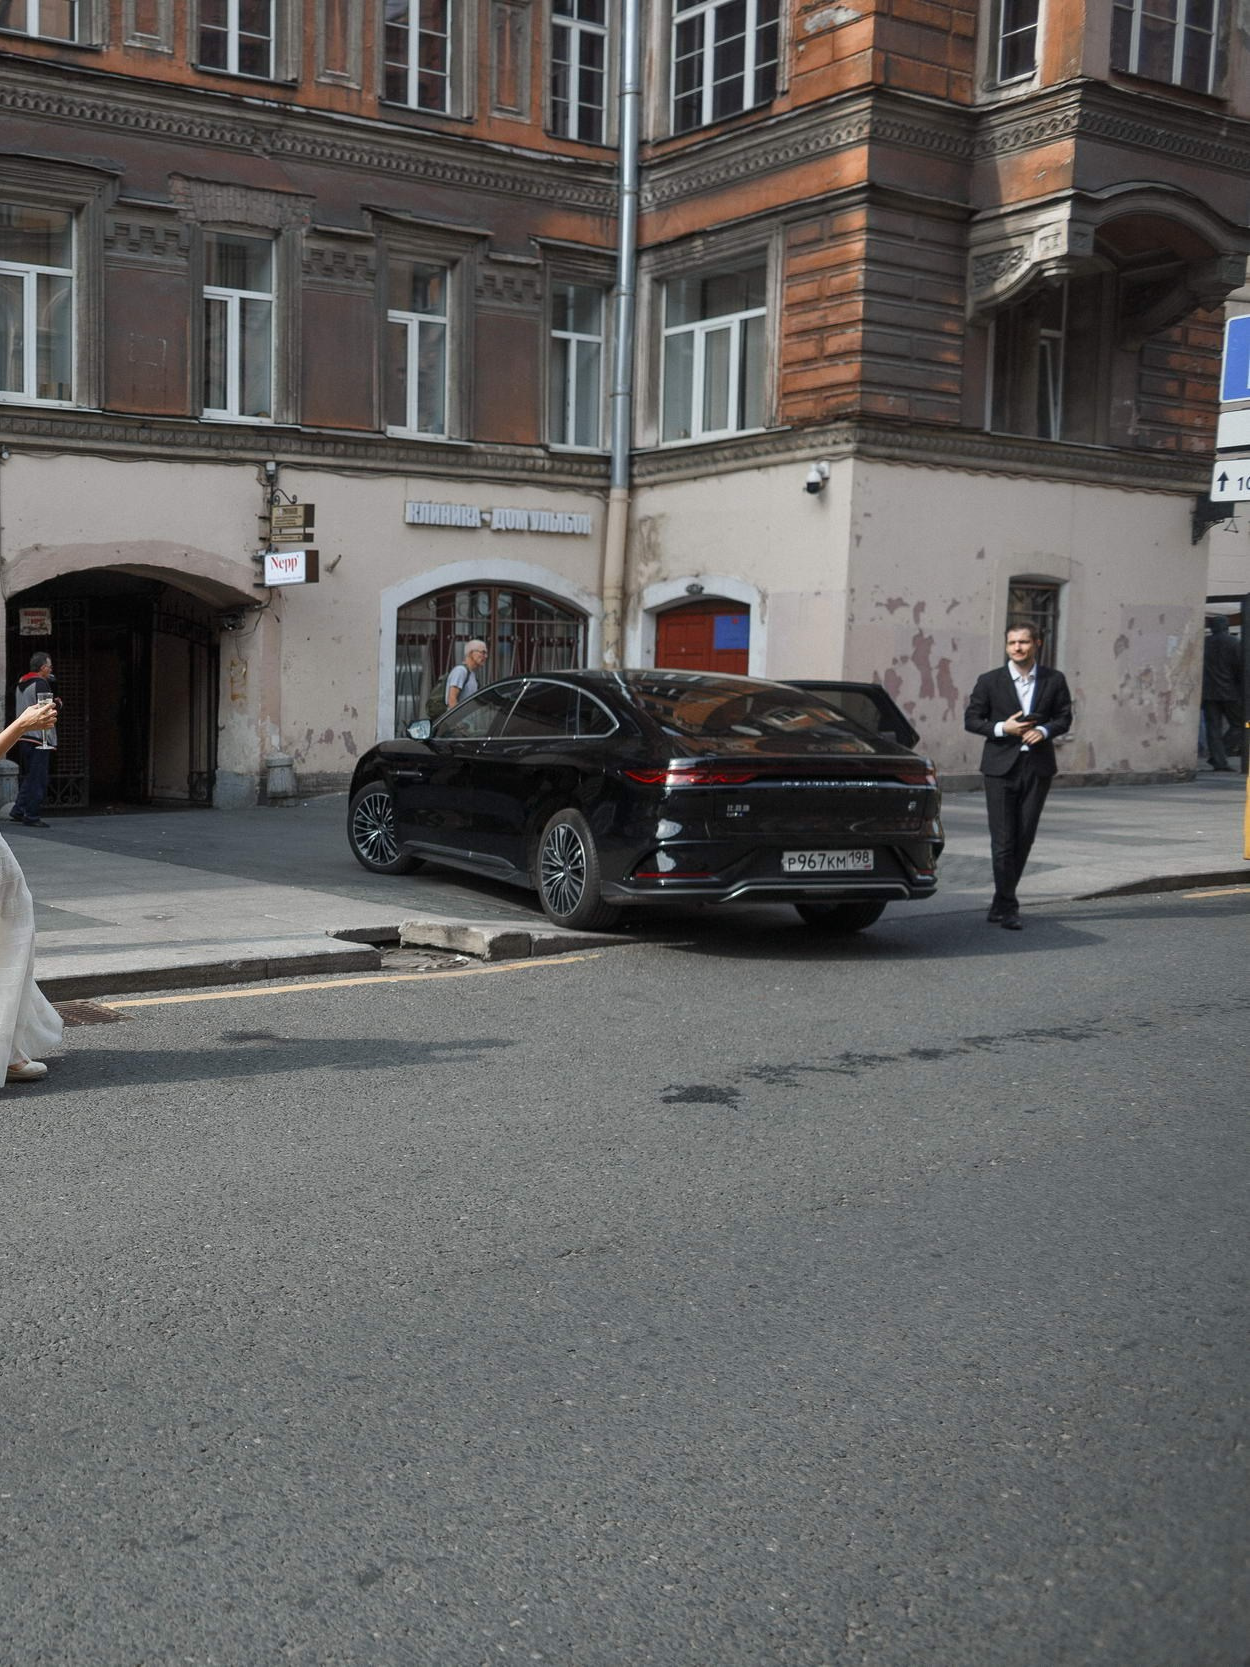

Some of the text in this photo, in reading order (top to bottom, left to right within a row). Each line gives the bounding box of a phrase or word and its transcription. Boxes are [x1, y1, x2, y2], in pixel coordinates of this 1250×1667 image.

[405, 502, 591, 534] КЛИНИКА ДОМ УЛЫБОК
[787, 851, 870, 870] Р967КМ 198
